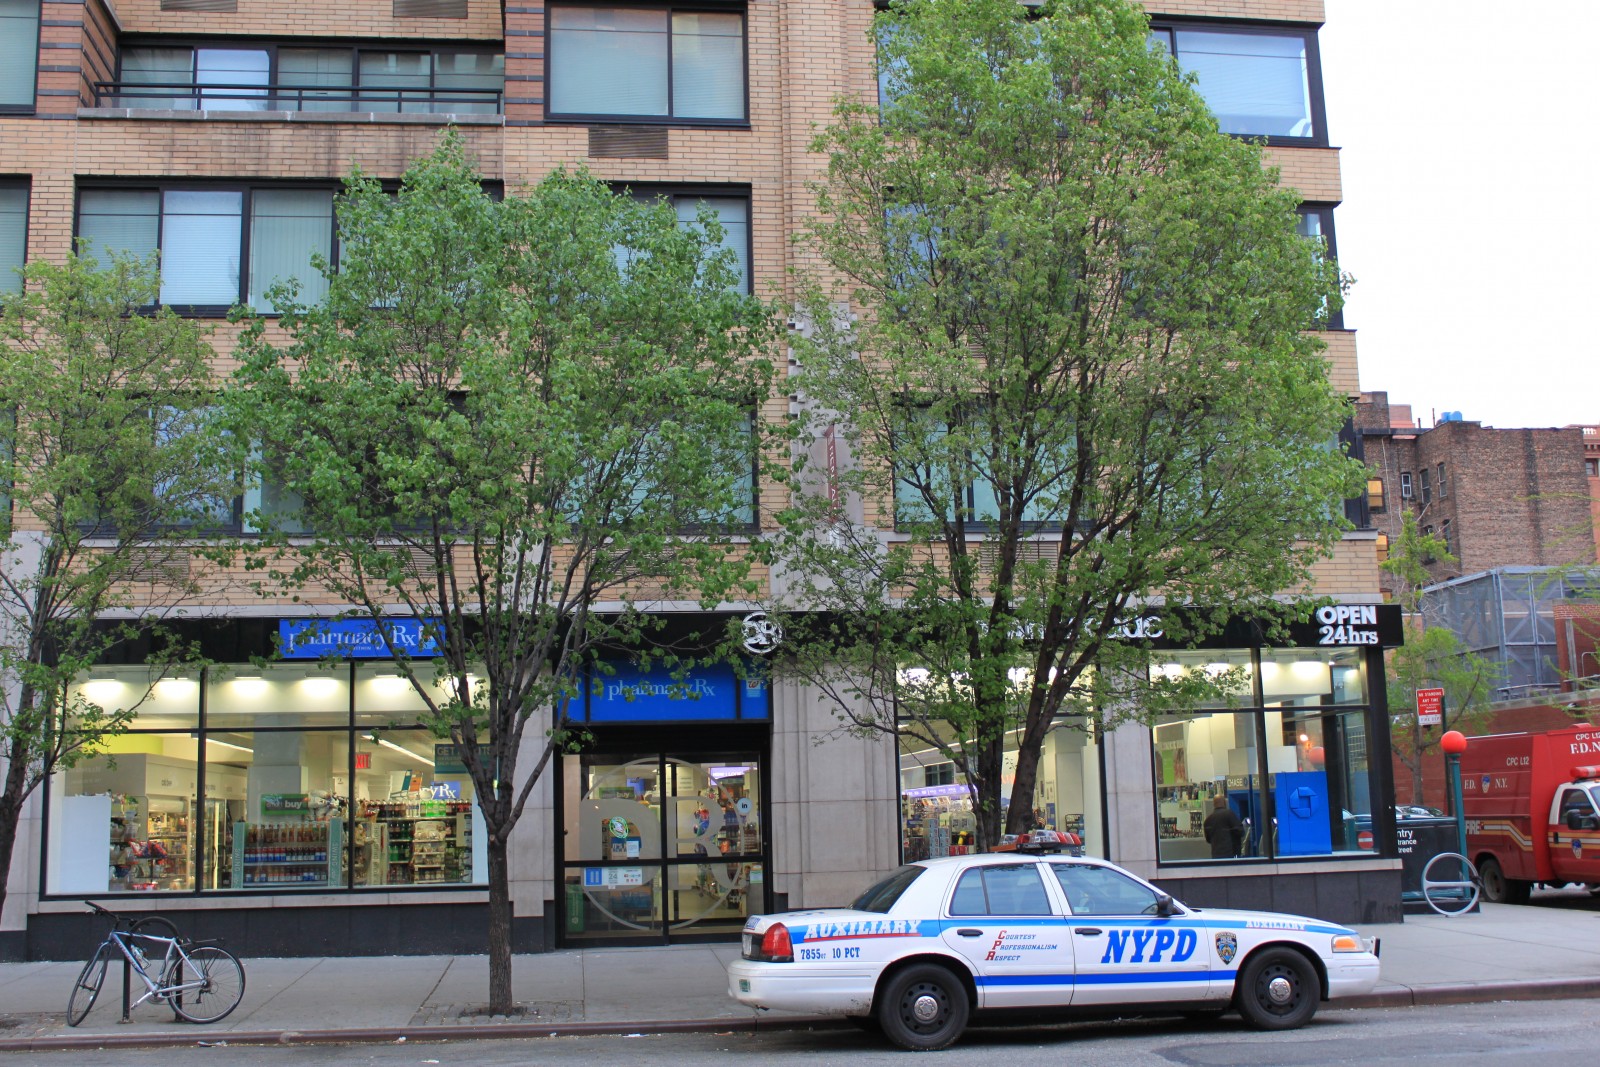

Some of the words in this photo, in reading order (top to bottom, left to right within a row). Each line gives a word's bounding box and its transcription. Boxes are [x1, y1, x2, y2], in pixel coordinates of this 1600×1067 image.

[1316, 605, 1377, 625] OPEN
[1319, 625, 1379, 645] 24hrs
[1575, 733, 1590, 741] CPC
[1506, 757, 1518, 766] CPC
[1519, 756, 1529, 765] L12
[1227, 777, 1243, 787] CHASE
[1465, 820, 1480, 834] FIRE
[1397, 829, 1413, 840] ntry
[1397, 846, 1413, 854] treet
[804, 919, 922, 939] AUXILIARY
[1245, 920, 1306, 931] AUXILIARY
[997, 930, 1037, 940] COURTESY
[991, 940, 1058, 951] PROFESSIONALISM
[1100, 928, 1198, 964] NYPD
[800, 949, 821, 960] 7855
[832, 947, 842, 959] 10
[844, 946, 861, 958] PCT
[985, 951, 1021, 961] RESPECT
